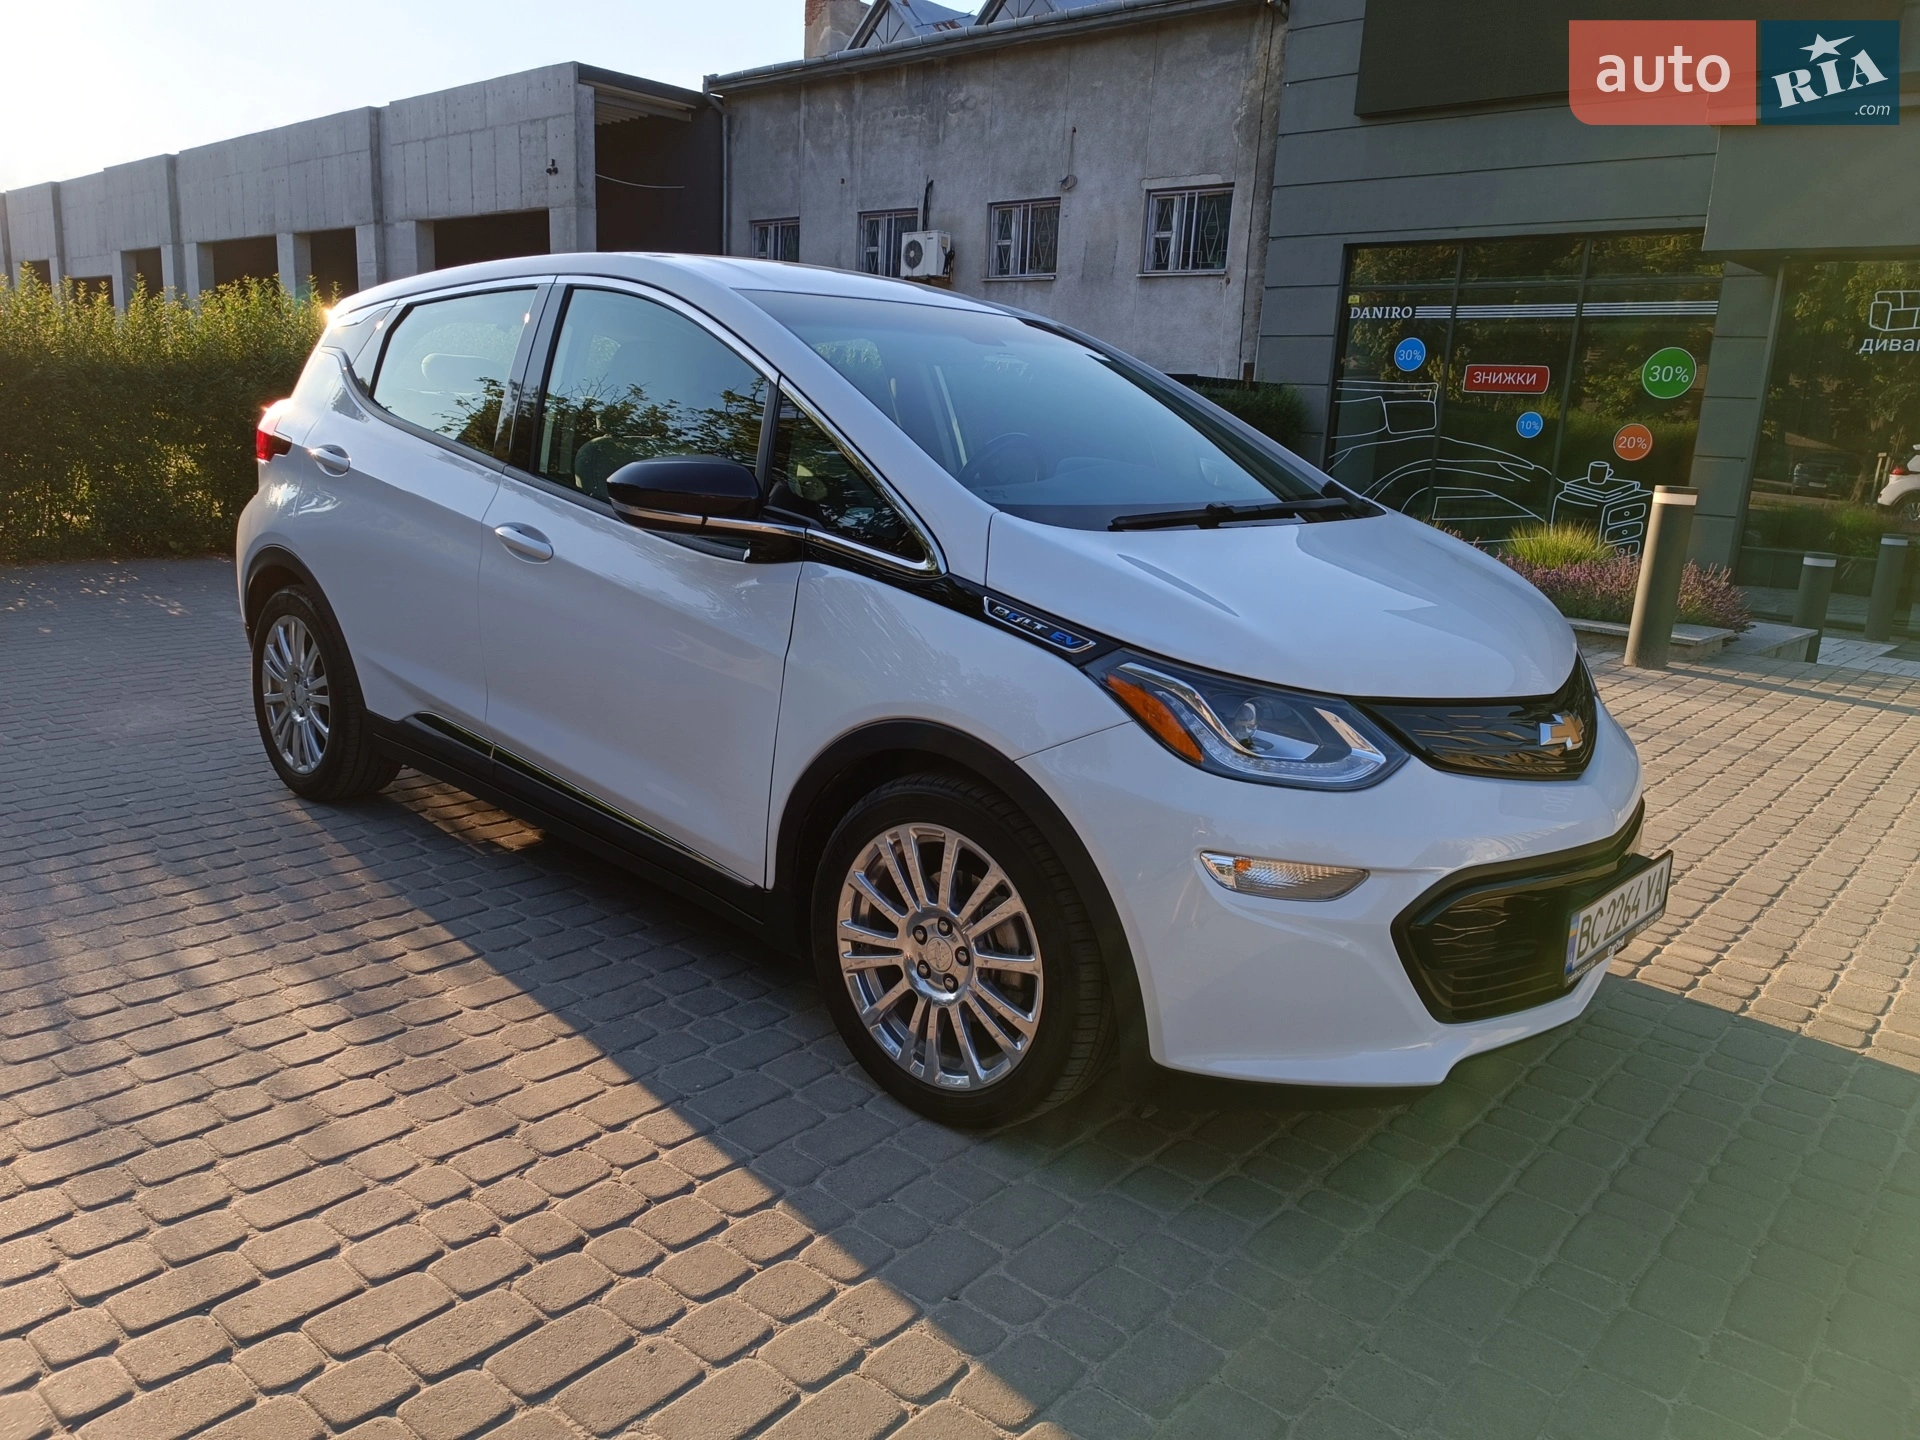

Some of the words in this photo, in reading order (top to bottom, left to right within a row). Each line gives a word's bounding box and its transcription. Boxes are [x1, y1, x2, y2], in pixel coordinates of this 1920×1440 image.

[1349, 306, 1413, 319] DANIRO
[1398, 349, 1422, 361] 30%
[1472, 371, 1537, 386] ЗНИЖКИ
[1648, 365, 1690, 383] 30%
[1520, 420, 1540, 431] 10%
[1617, 436, 1648, 450] 20%
[992, 605, 1048, 631] BOLT
[1050, 631, 1082, 646] EV
[1576, 907, 1603, 960] BC
[1603, 880, 1643, 942] 2264
